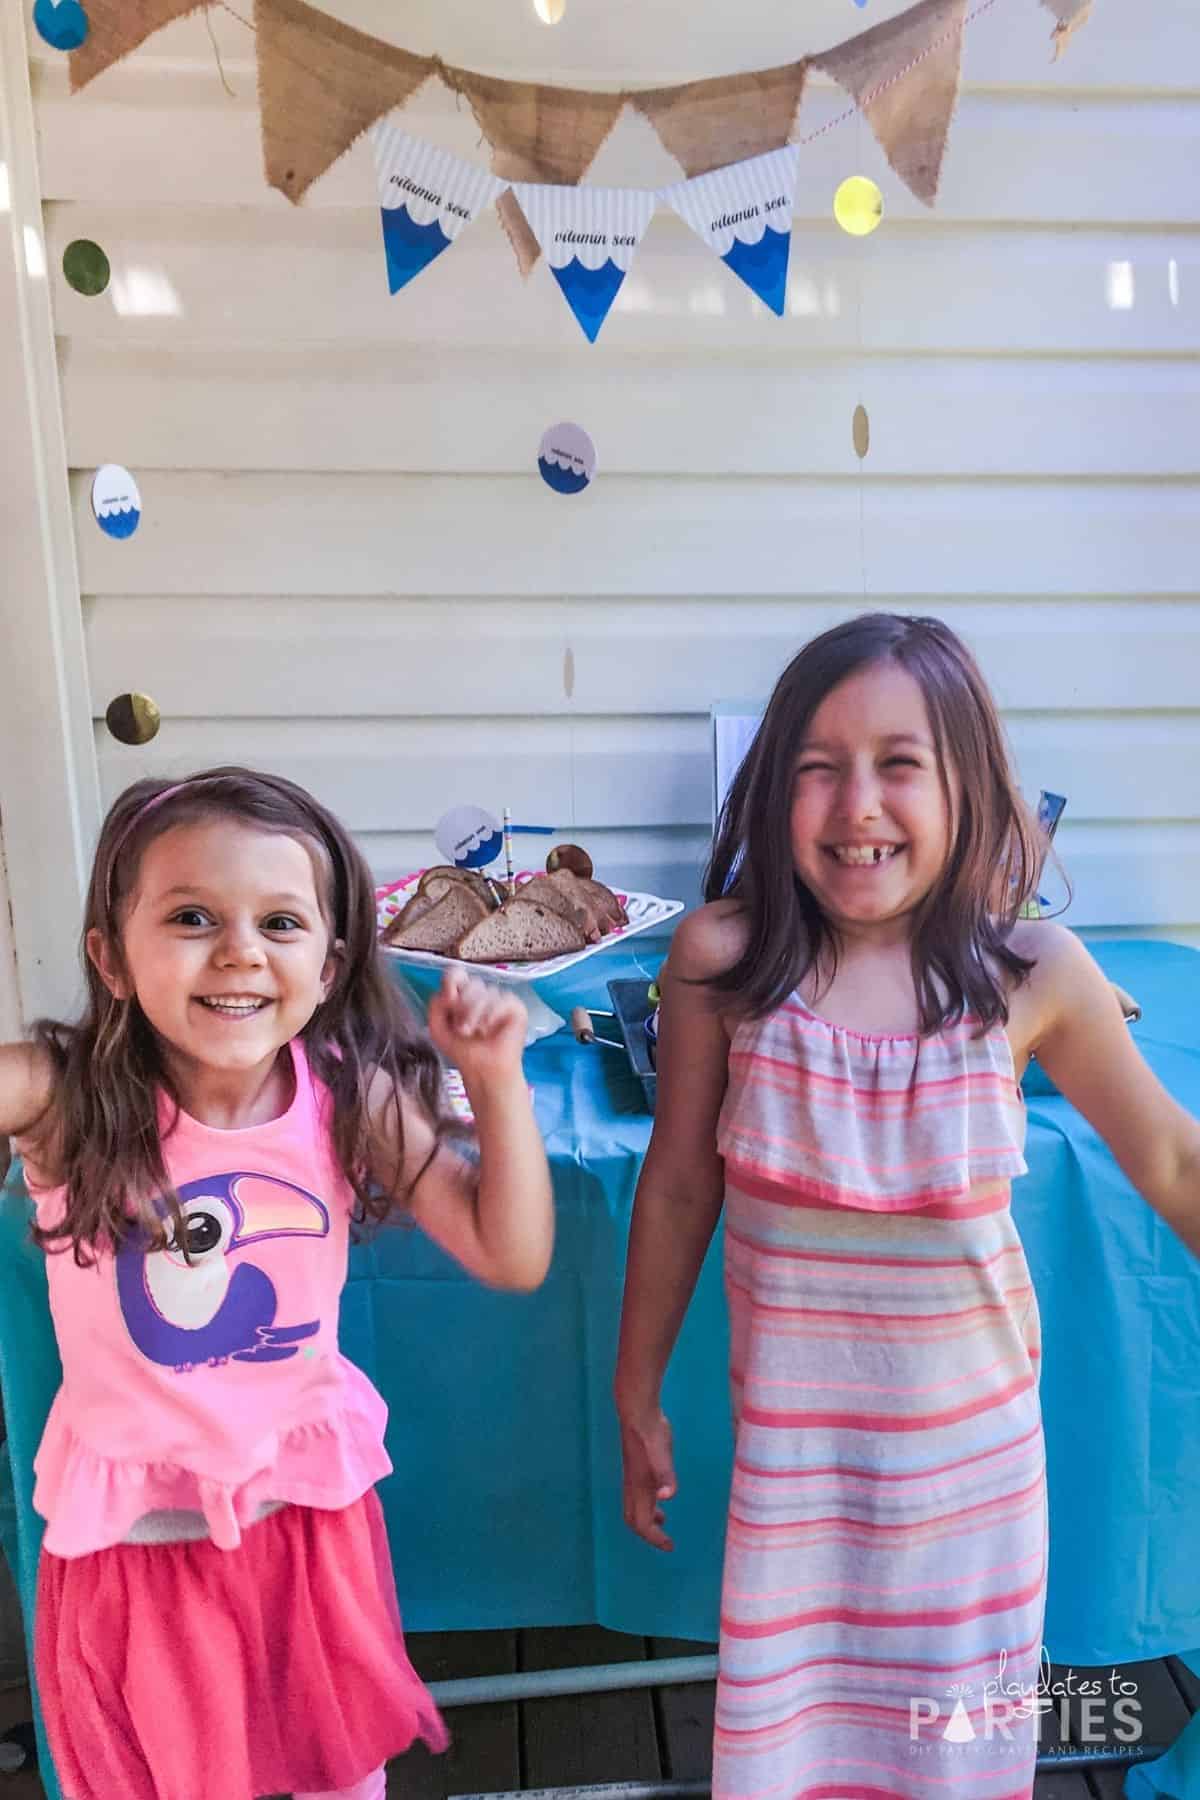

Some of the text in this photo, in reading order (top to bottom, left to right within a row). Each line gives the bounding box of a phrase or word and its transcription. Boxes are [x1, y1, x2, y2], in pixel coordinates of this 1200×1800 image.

[389, 174, 442, 206] vitamin
[709, 204, 760, 232] vitamin
[554, 230, 608, 246] vitamin
